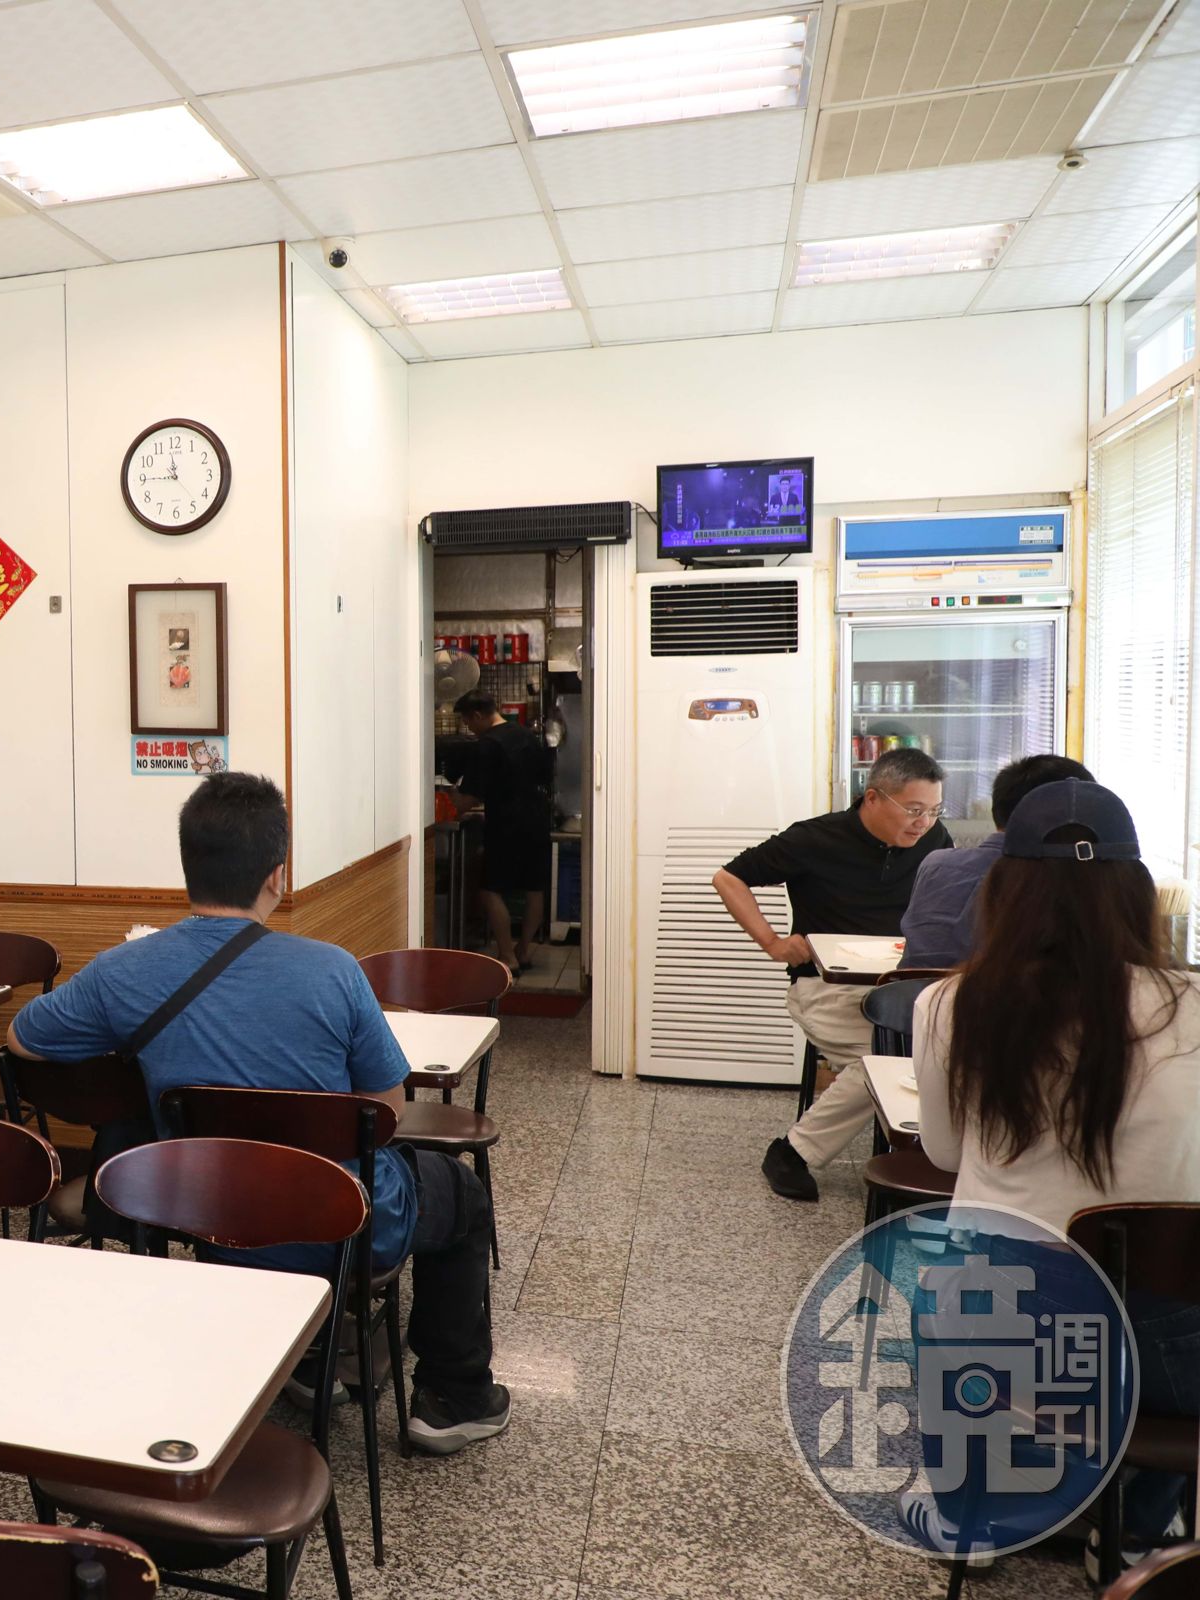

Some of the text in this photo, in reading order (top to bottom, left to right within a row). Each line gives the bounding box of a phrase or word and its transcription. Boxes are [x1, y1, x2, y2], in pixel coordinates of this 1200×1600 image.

[154, 442, 164, 455] 11
[169, 436, 181, 449] 12
[189, 440, 194, 452] 1
[141, 455, 154, 468] 10
[200, 451, 208, 464] 2
[139, 474, 147, 486] 9
[206, 469, 213, 482] 3
[144, 490, 151, 503] 8
[201, 487, 208, 500] 4
[156, 502, 164, 515] 7
[172, 506, 180, 519] 6
[189, 501, 196, 513] 5
[136, 759, 188, 769] NO SMOKING
